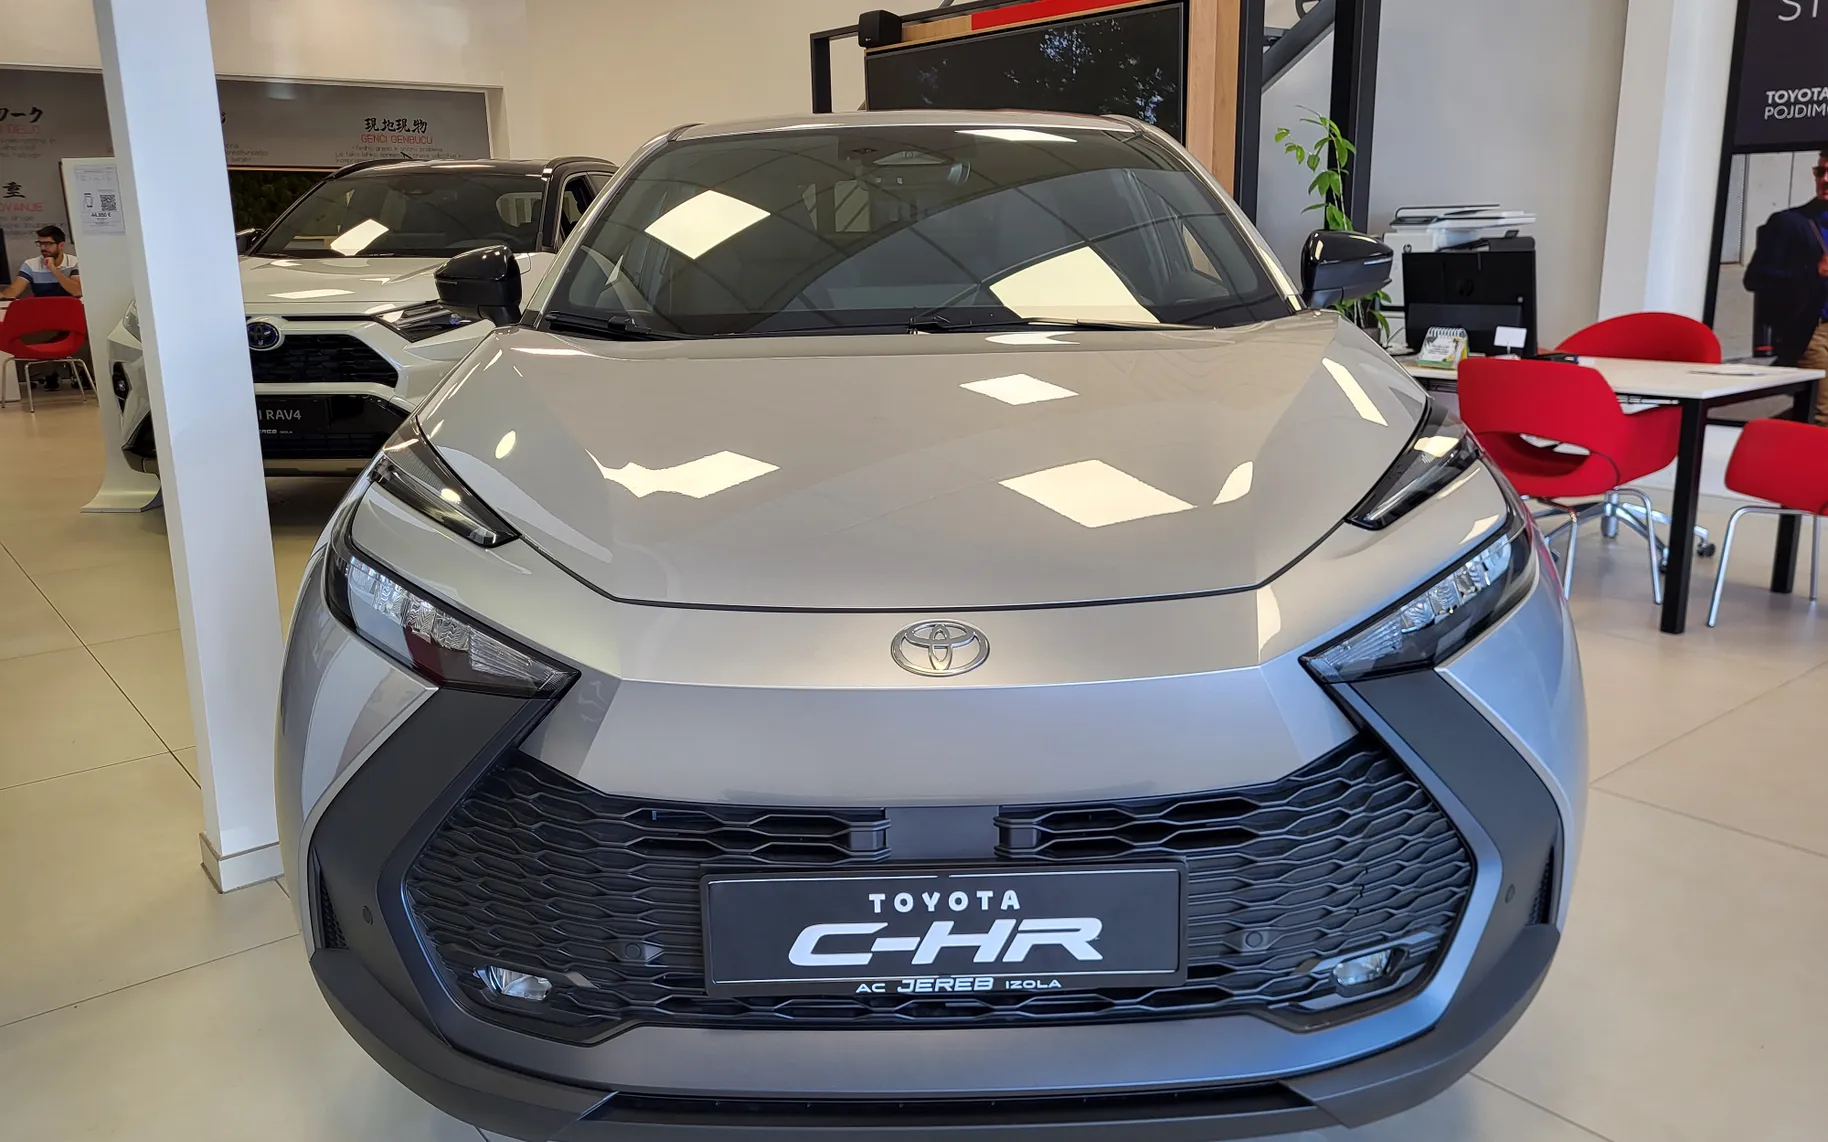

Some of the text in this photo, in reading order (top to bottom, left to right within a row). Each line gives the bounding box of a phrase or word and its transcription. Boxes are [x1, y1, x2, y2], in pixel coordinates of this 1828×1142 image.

[1766, 87, 1828, 104] TOYOTA
[1764, 103, 1828, 120] POJDIM
[364, 117, 428, 134] 現地現物
[265, 409, 302, 420] RAV4
[868, 889, 1020, 914] TOYOTA
[788, 916, 1104, 967] C-HR
[855, 977, 1062, 993] AC JEREB IZOLA
